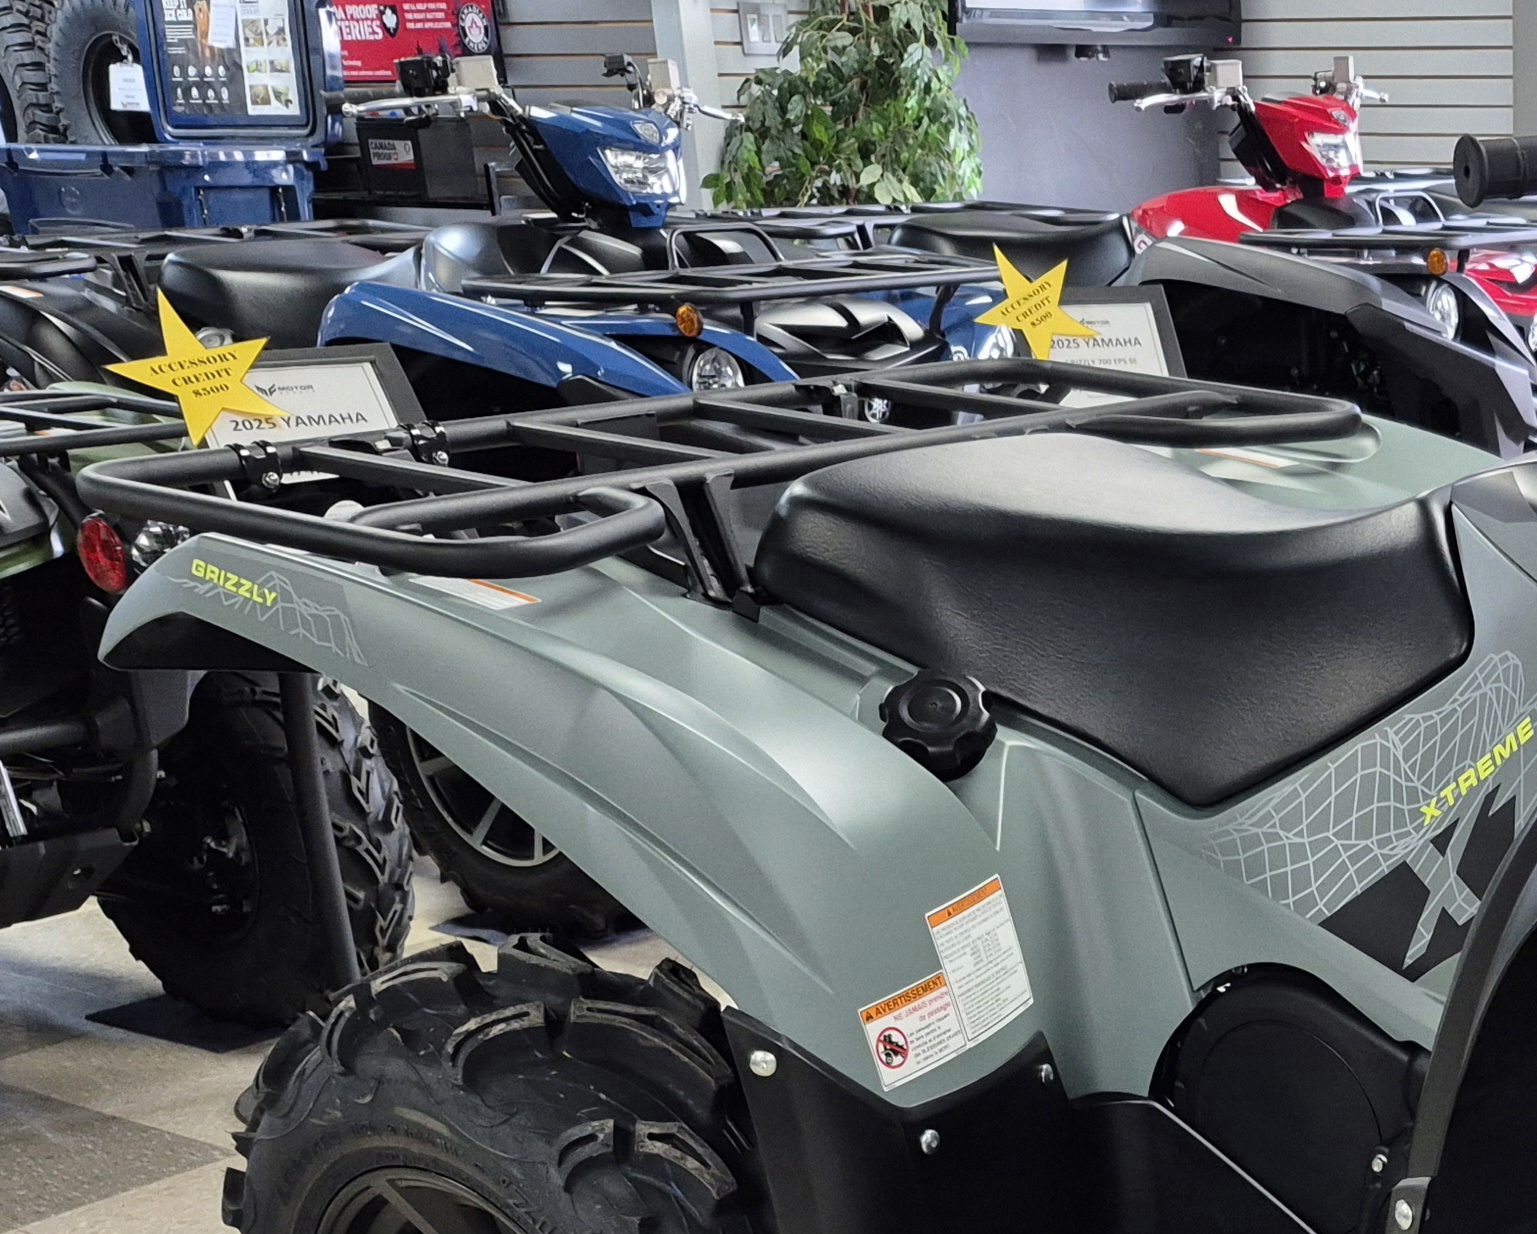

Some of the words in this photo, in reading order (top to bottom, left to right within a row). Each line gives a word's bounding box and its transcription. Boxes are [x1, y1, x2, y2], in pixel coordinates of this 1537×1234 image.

[349, 4, 378, 19] PROOF
[338, 20, 383, 41] TERIES
[1015, 296, 1051, 324] CREDIT
[1050, 338, 1080, 350] 2025
[1084, 336, 1142, 348] YAMAHA
[150, 349, 239, 376] ACCESSORY
[171, 367, 234, 388] CREDIT
[192, 383, 230, 399] $500
[278, 384, 314, 393] MOTOR
[229, 418, 277, 432] 2025
[282, 411, 369, 430] YAMAHA
[191, 558, 278, 607] GRIZZLY
[1420, 716, 1535, 827] XTREME
[875, 975, 943, 1017] AVERTISSEMENT
